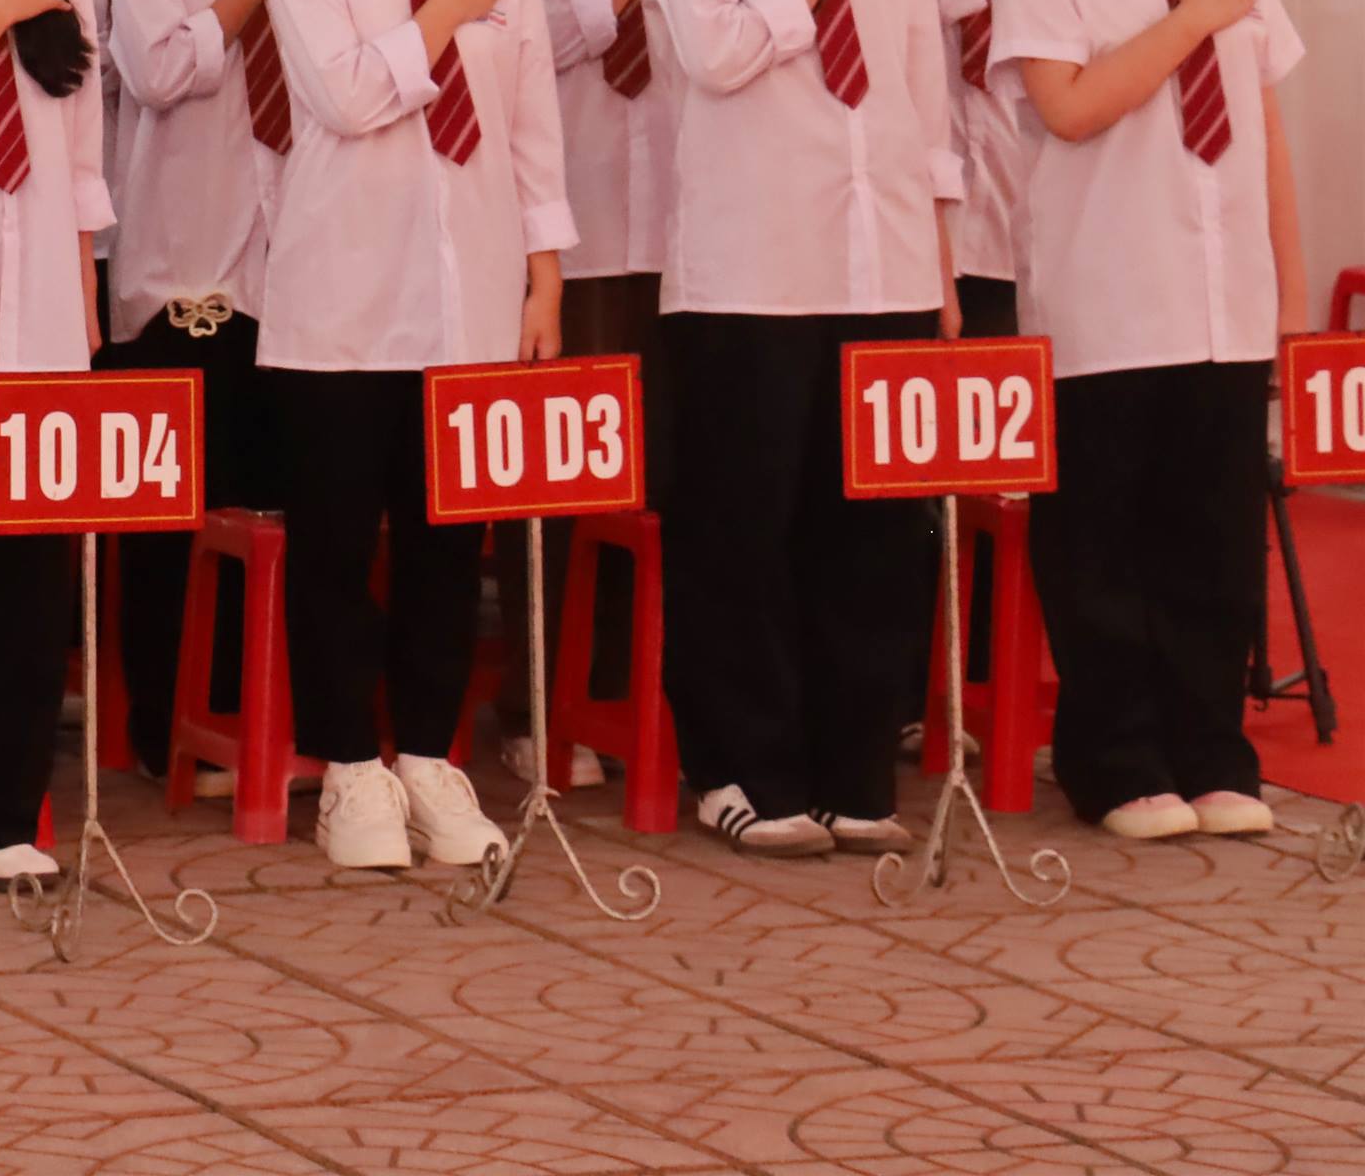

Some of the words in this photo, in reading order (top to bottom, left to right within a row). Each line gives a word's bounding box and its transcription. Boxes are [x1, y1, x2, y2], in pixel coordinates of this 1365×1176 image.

[0, 410, 78, 502] 10
[100, 411, 182, 499] D4
[448, 398, 524, 489] 10
[544, 393, 624, 482] D3
[863, 376, 938, 465] 10
[957, 375, 1035, 461] D2
